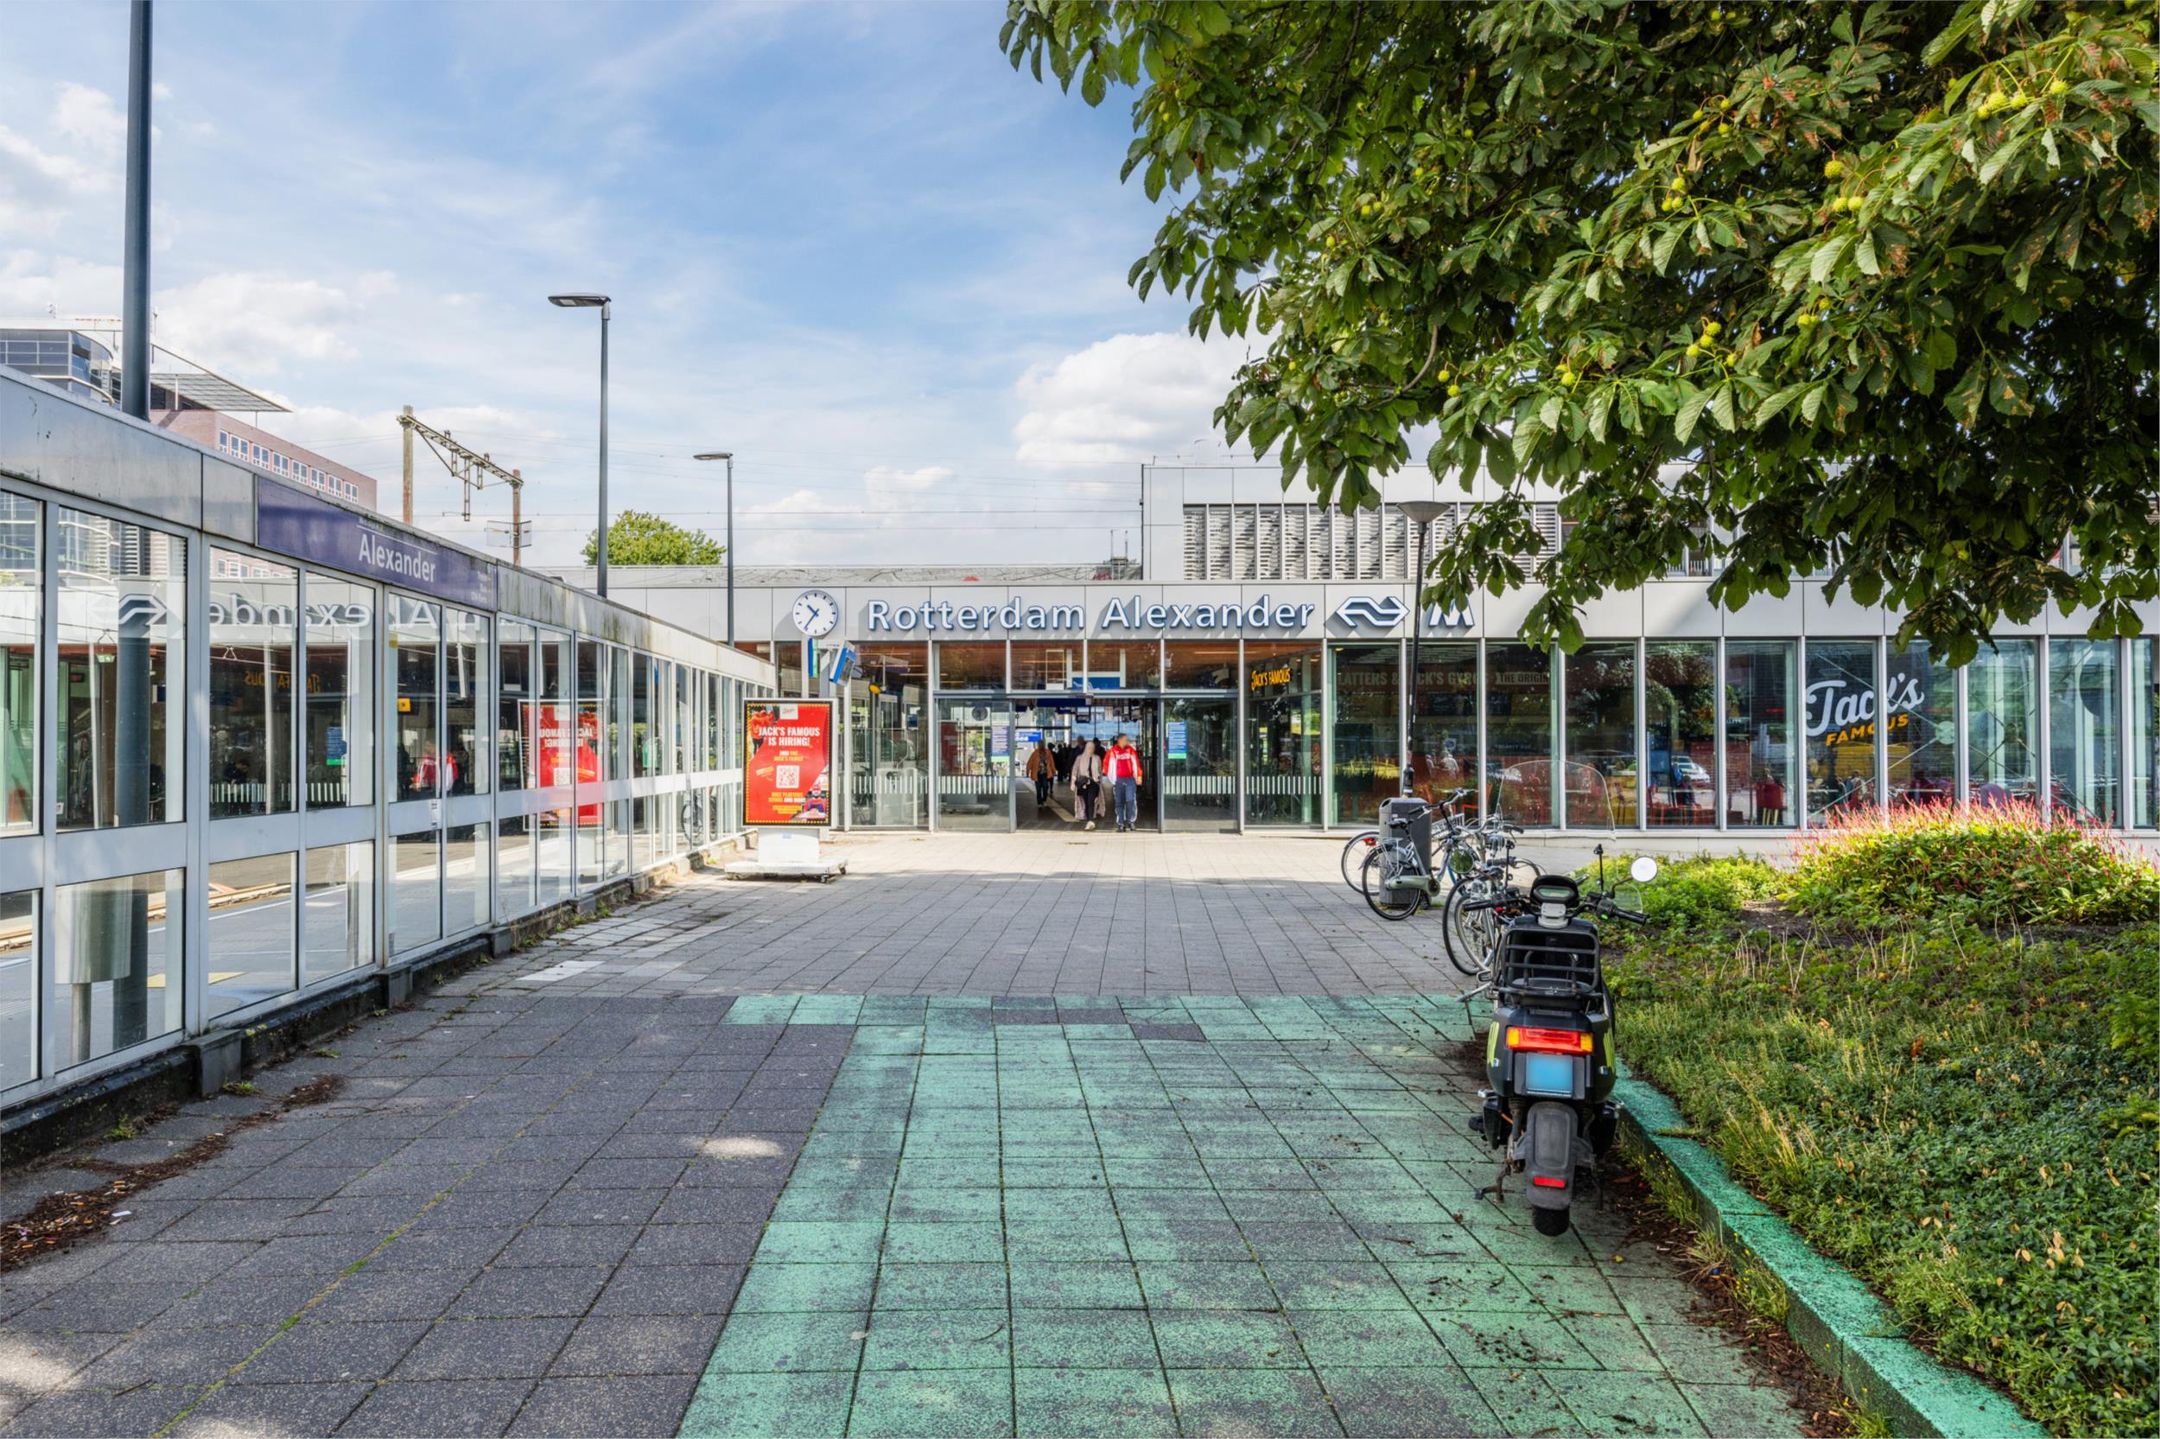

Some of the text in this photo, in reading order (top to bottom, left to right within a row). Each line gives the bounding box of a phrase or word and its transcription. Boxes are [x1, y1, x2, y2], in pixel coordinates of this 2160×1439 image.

[358, 533, 436, 583] Alexander
[867, 594, 1315, 631] Rotterdam Alexander
[1337, 672, 1388, 686] LATTERS
[758, 726, 820, 737] JACK'S FAMOUS
[768, 737, 810, 747] IS HIRING!
